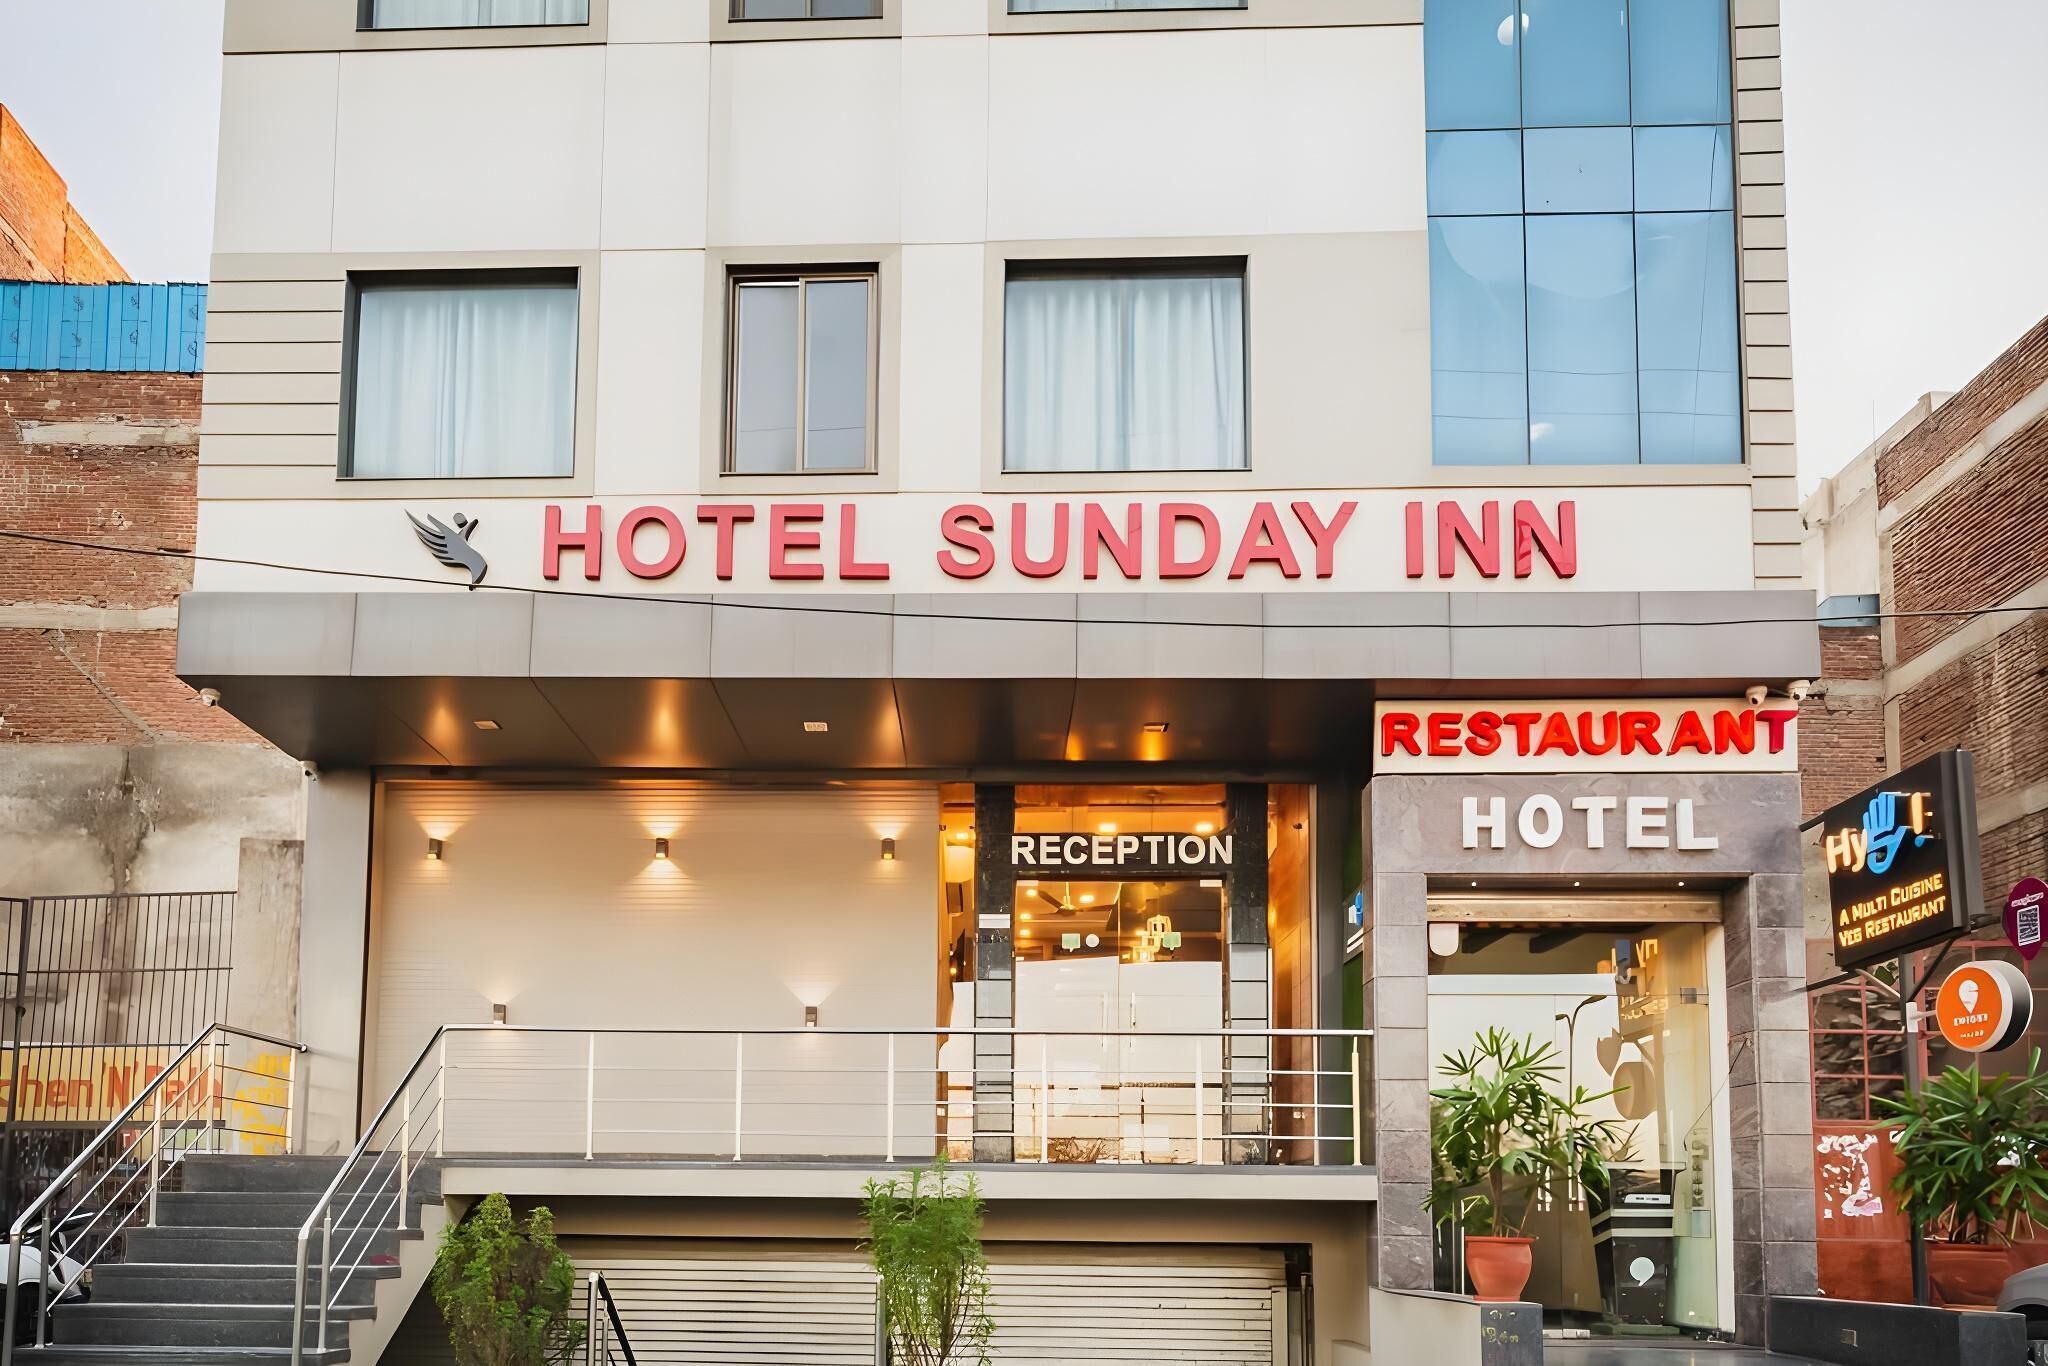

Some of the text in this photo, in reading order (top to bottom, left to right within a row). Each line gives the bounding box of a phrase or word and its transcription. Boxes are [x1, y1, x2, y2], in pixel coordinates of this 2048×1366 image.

[543, 499, 1577, 581] HOTEL SUNDAY INN
[1381, 709, 1799, 757] RESTAURANT
[1462, 793, 1719, 850] HOTEL
[1011, 835, 1233, 865] RECEPTION
[1839, 908, 1850, 926] A
[1865, 895, 1946, 939] RESTAURANT
